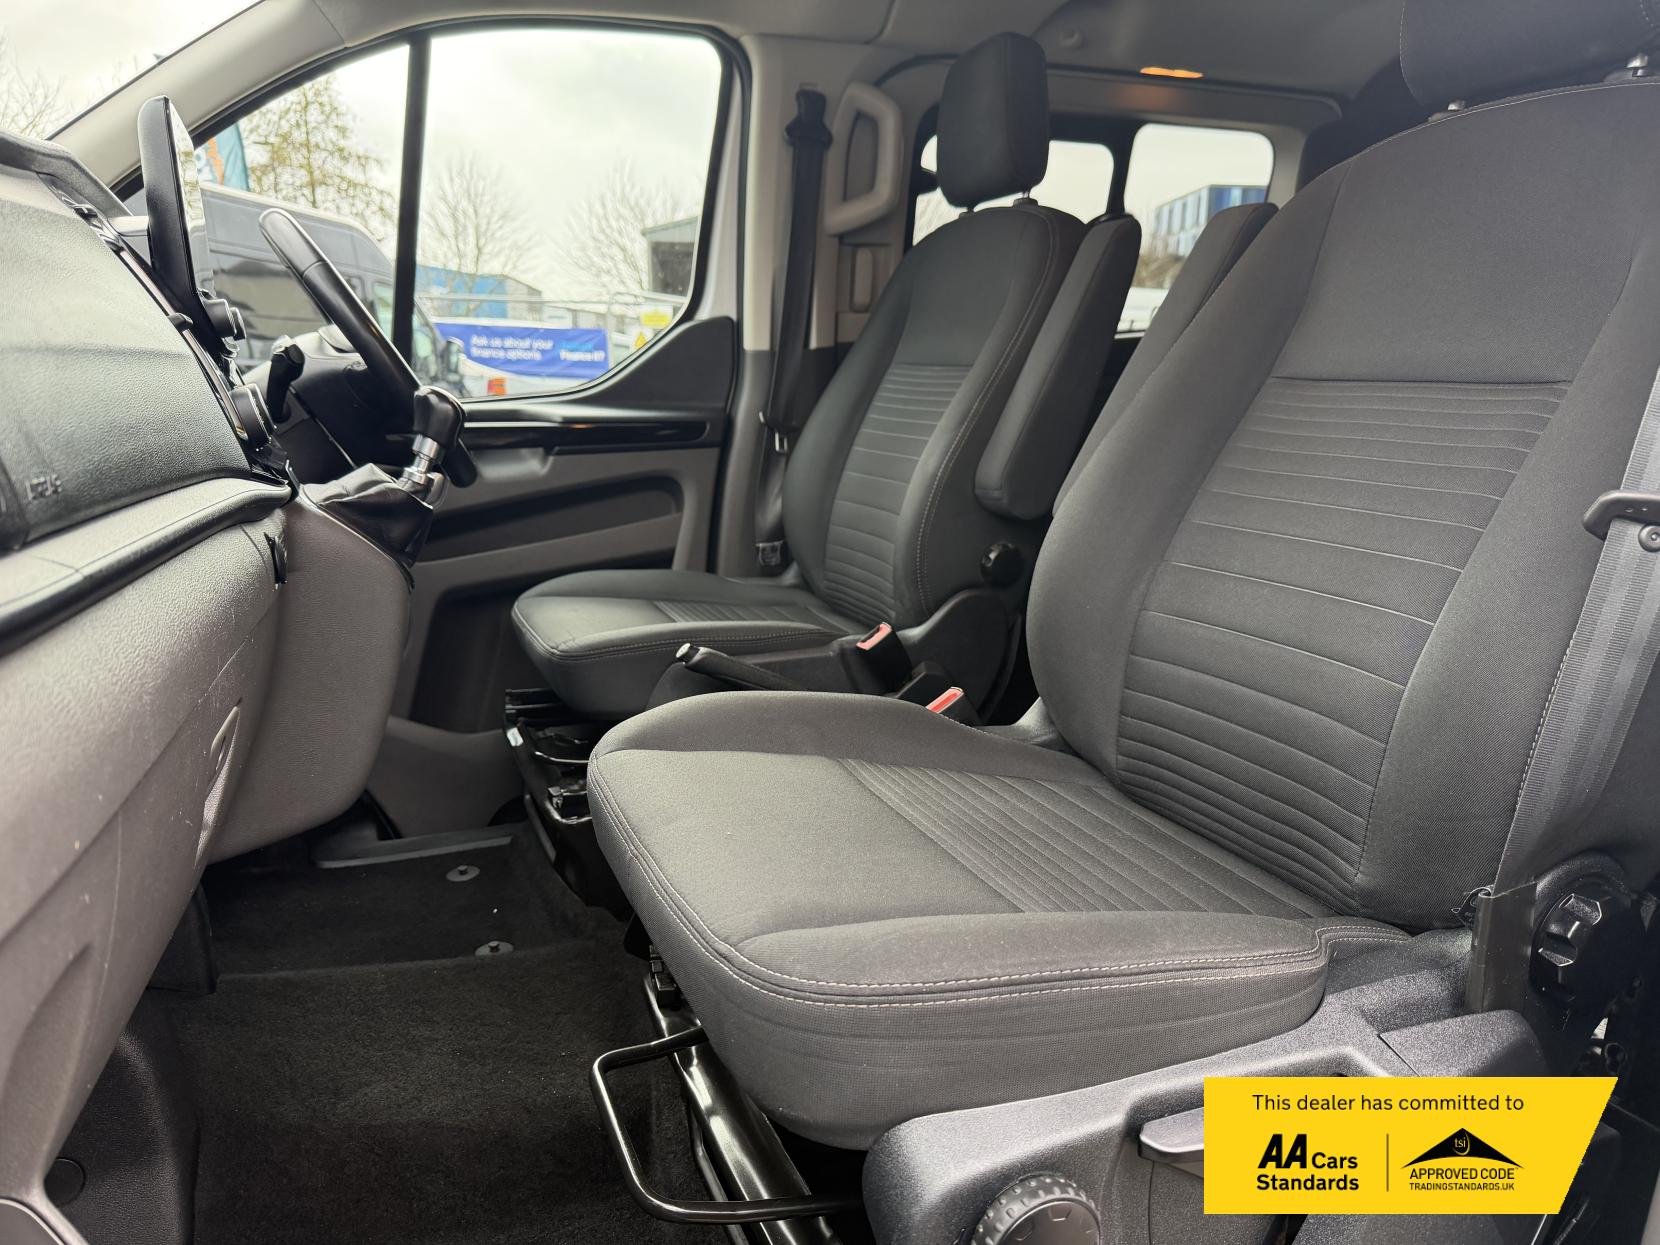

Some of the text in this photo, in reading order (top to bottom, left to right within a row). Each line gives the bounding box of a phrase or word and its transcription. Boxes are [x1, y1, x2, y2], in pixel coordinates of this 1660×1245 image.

[471, 335, 488, 347] Ask
[504, 337, 531, 349] about
[533, 339, 553, 350] your
[507, 349, 542, 361] options
